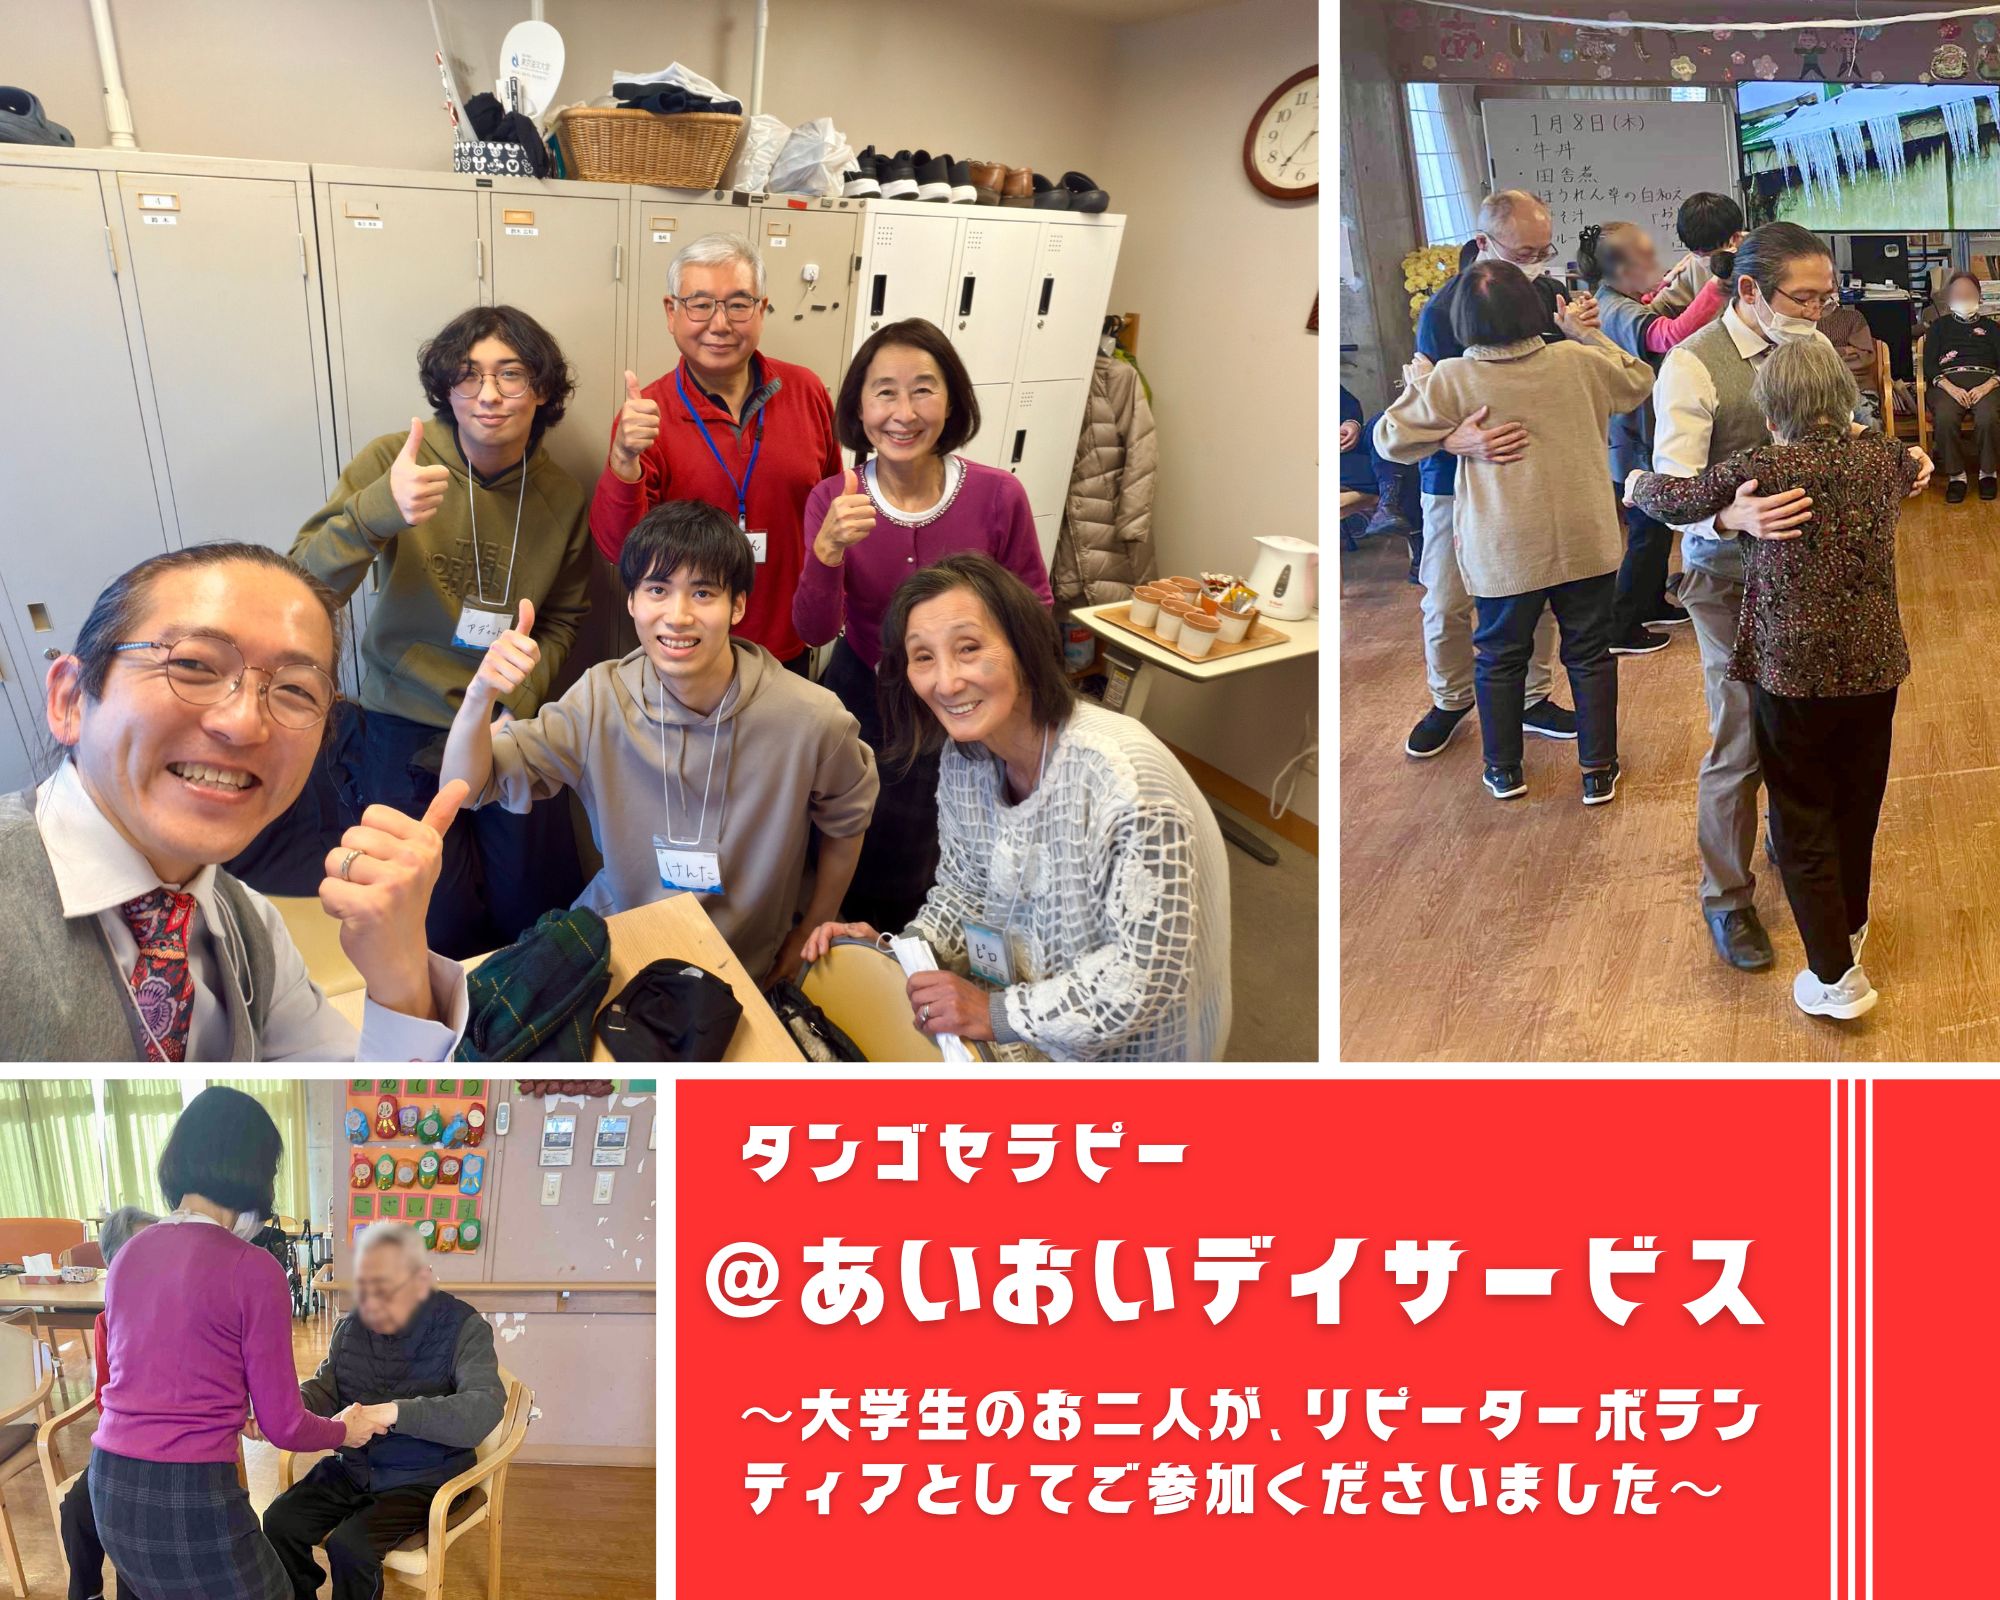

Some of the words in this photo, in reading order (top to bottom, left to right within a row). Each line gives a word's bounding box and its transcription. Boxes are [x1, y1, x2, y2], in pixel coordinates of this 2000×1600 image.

[1295, 91, 1308, 105] 11
[1276, 108, 1292, 123] 10
[1268, 130, 1279, 144] 9
[1267, 149, 1278, 163] 8
[1295, 168, 1306, 181] 6
[665, 861, 715, 883] けんた
